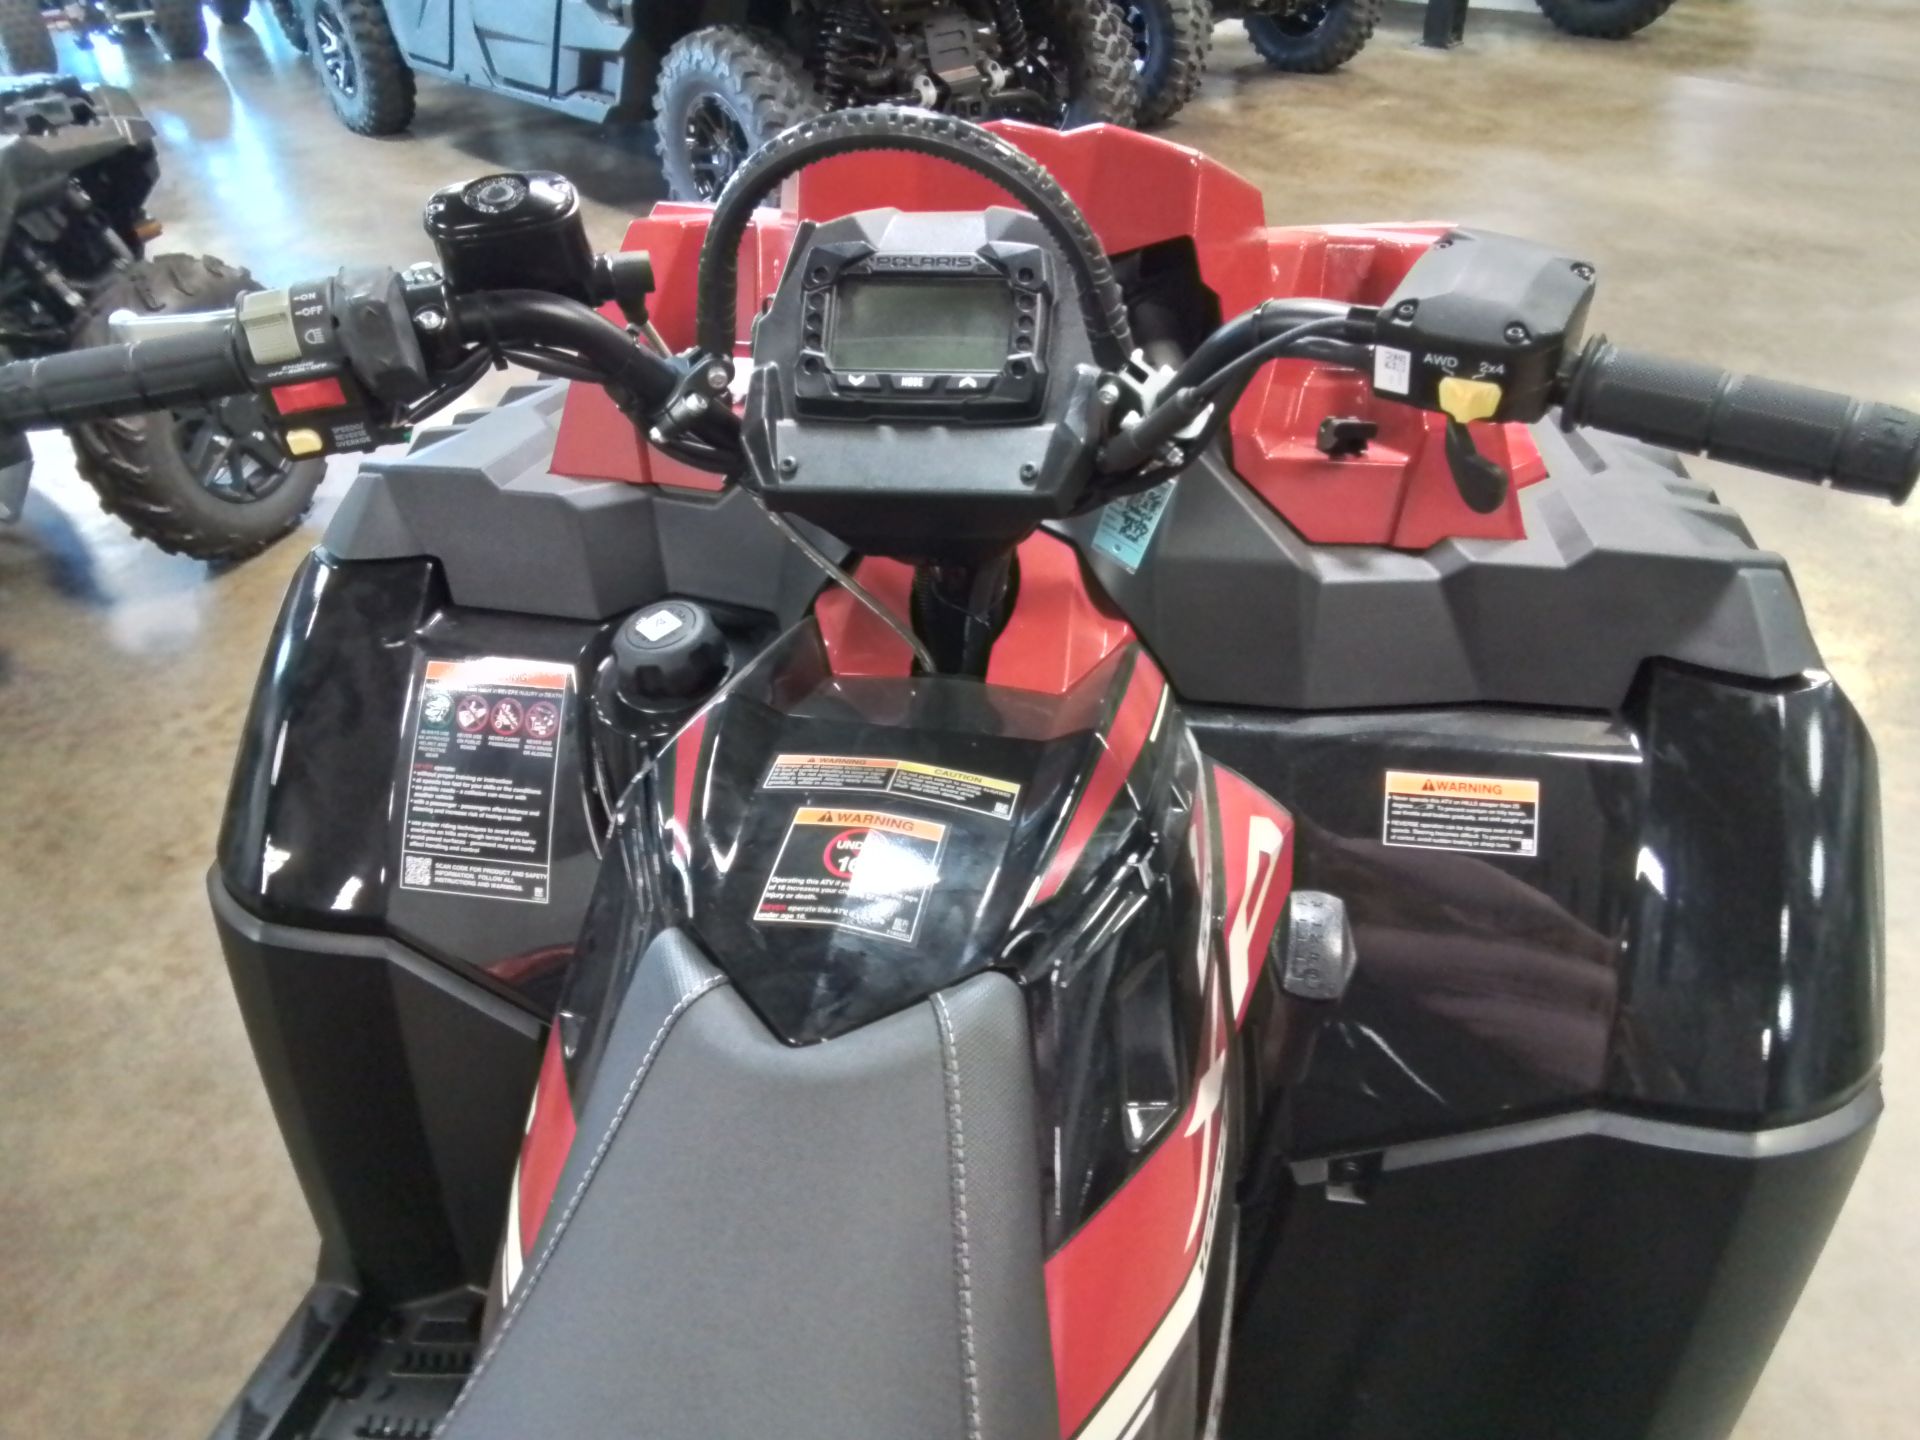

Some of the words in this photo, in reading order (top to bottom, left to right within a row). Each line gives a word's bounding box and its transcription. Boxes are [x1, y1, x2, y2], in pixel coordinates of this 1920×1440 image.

[877, 257, 971, 267] POLARIS
[302, 306, 323, 316] OFF
[1423, 353, 1458, 367] AWD
[1480, 362, 1505, 374] 2x4
[934, 769, 983, 783] CAUTION
[1437, 781, 1502, 795] WARNING
[838, 812, 914, 831] WARNING
